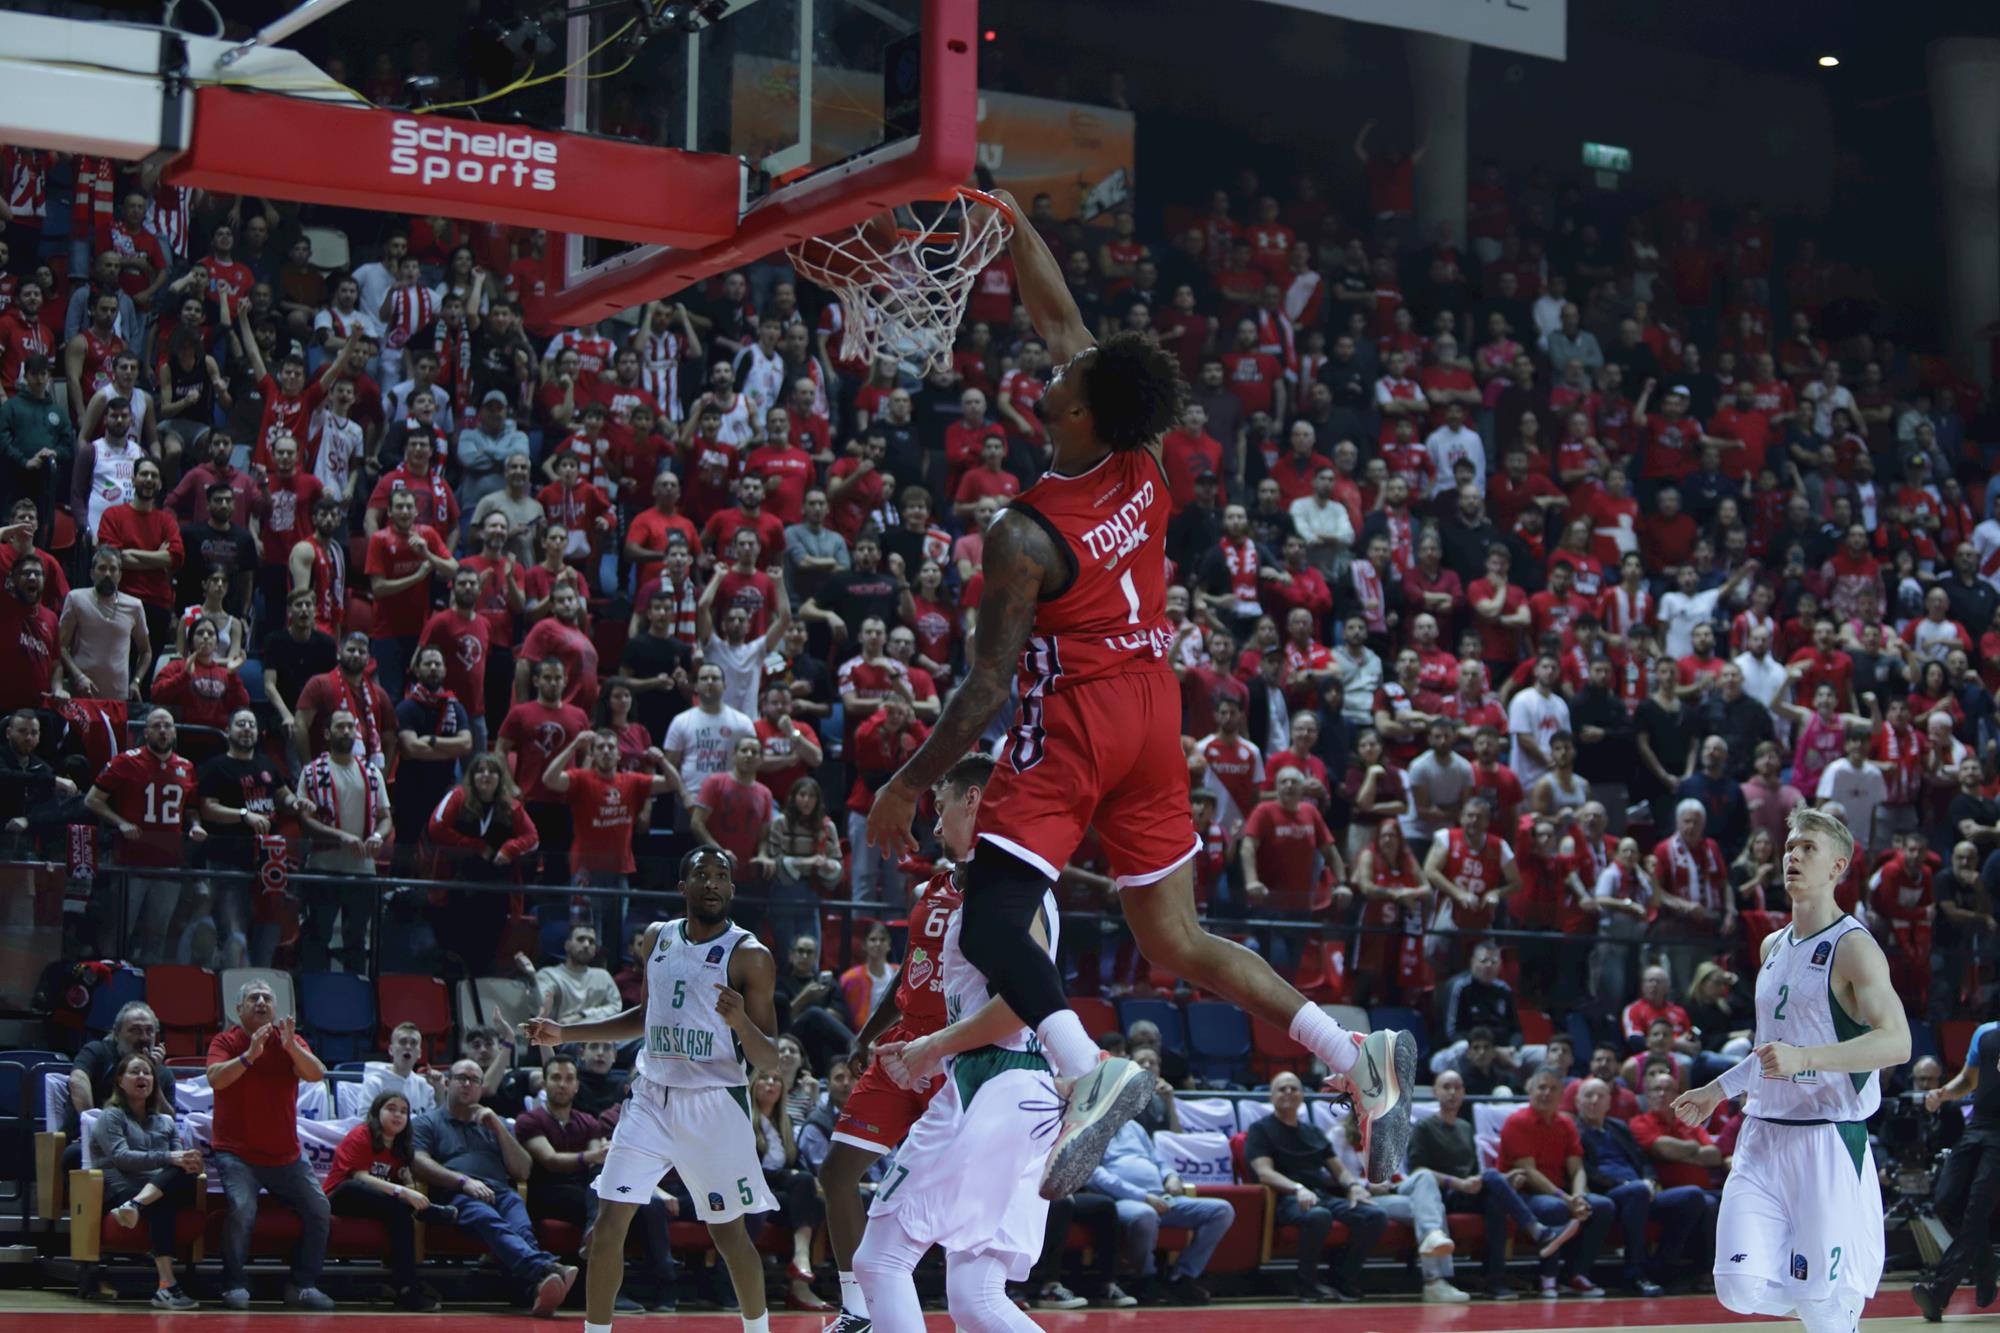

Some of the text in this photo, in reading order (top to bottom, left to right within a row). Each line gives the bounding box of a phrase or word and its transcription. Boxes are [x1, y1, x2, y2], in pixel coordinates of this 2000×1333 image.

[392, 119, 558, 164] Schelde
[390, 146, 557, 191] Sports
[1120, 568, 1140, 624] 1
[144, 782, 184, 824] 12
[672, 980, 686, 1009] 5
[1774, 985, 1789, 1020] 2
[672, 1023, 714, 1061] ŚLĄSK
[737, 1177, 753, 1206] 5
[1829, 1246, 1841, 1281] 2
